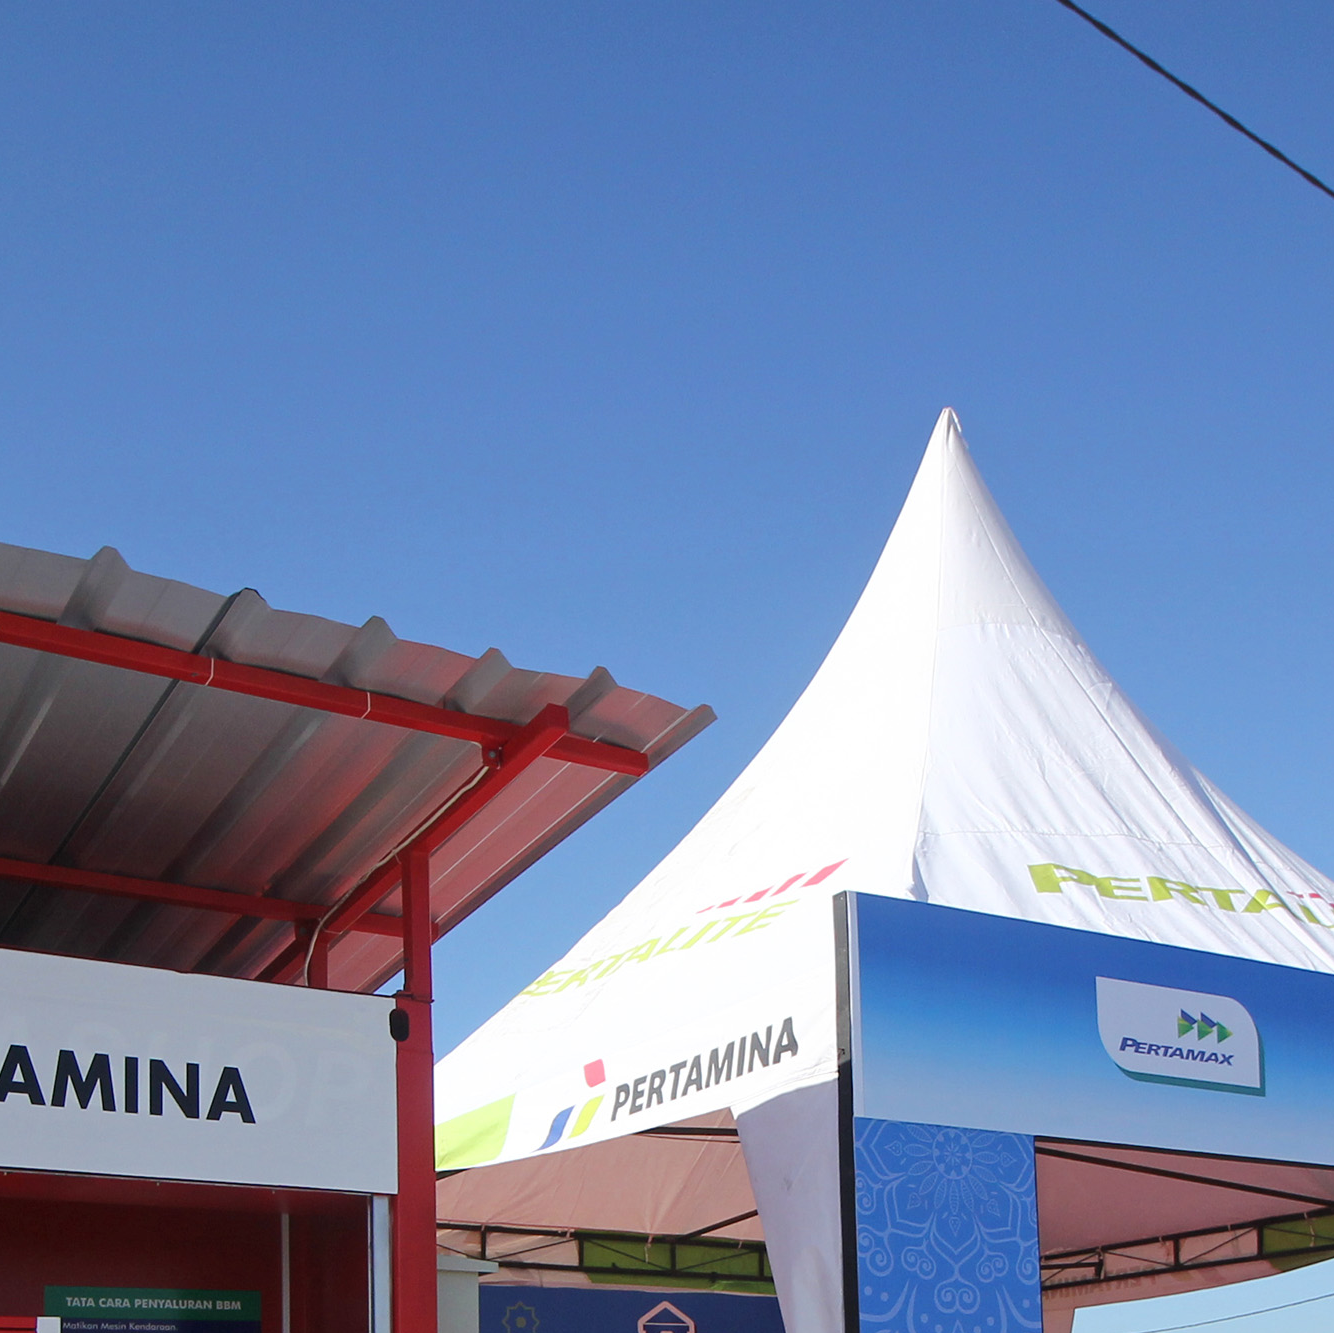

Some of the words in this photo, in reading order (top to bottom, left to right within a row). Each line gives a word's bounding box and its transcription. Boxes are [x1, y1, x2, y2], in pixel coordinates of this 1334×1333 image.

[520, 899, 800, 996] ERTALITE
[610, 1017, 798, 1121] PERTAMINA
[1119, 1037, 1234, 1065] PERTAMAX
[66, 1297, 94, 1307] TATA
[99, 1298, 130, 1308] CARA
[135, 1299, 212, 1310] PENYALURAN
[216, 1301, 241, 1310] BBM
